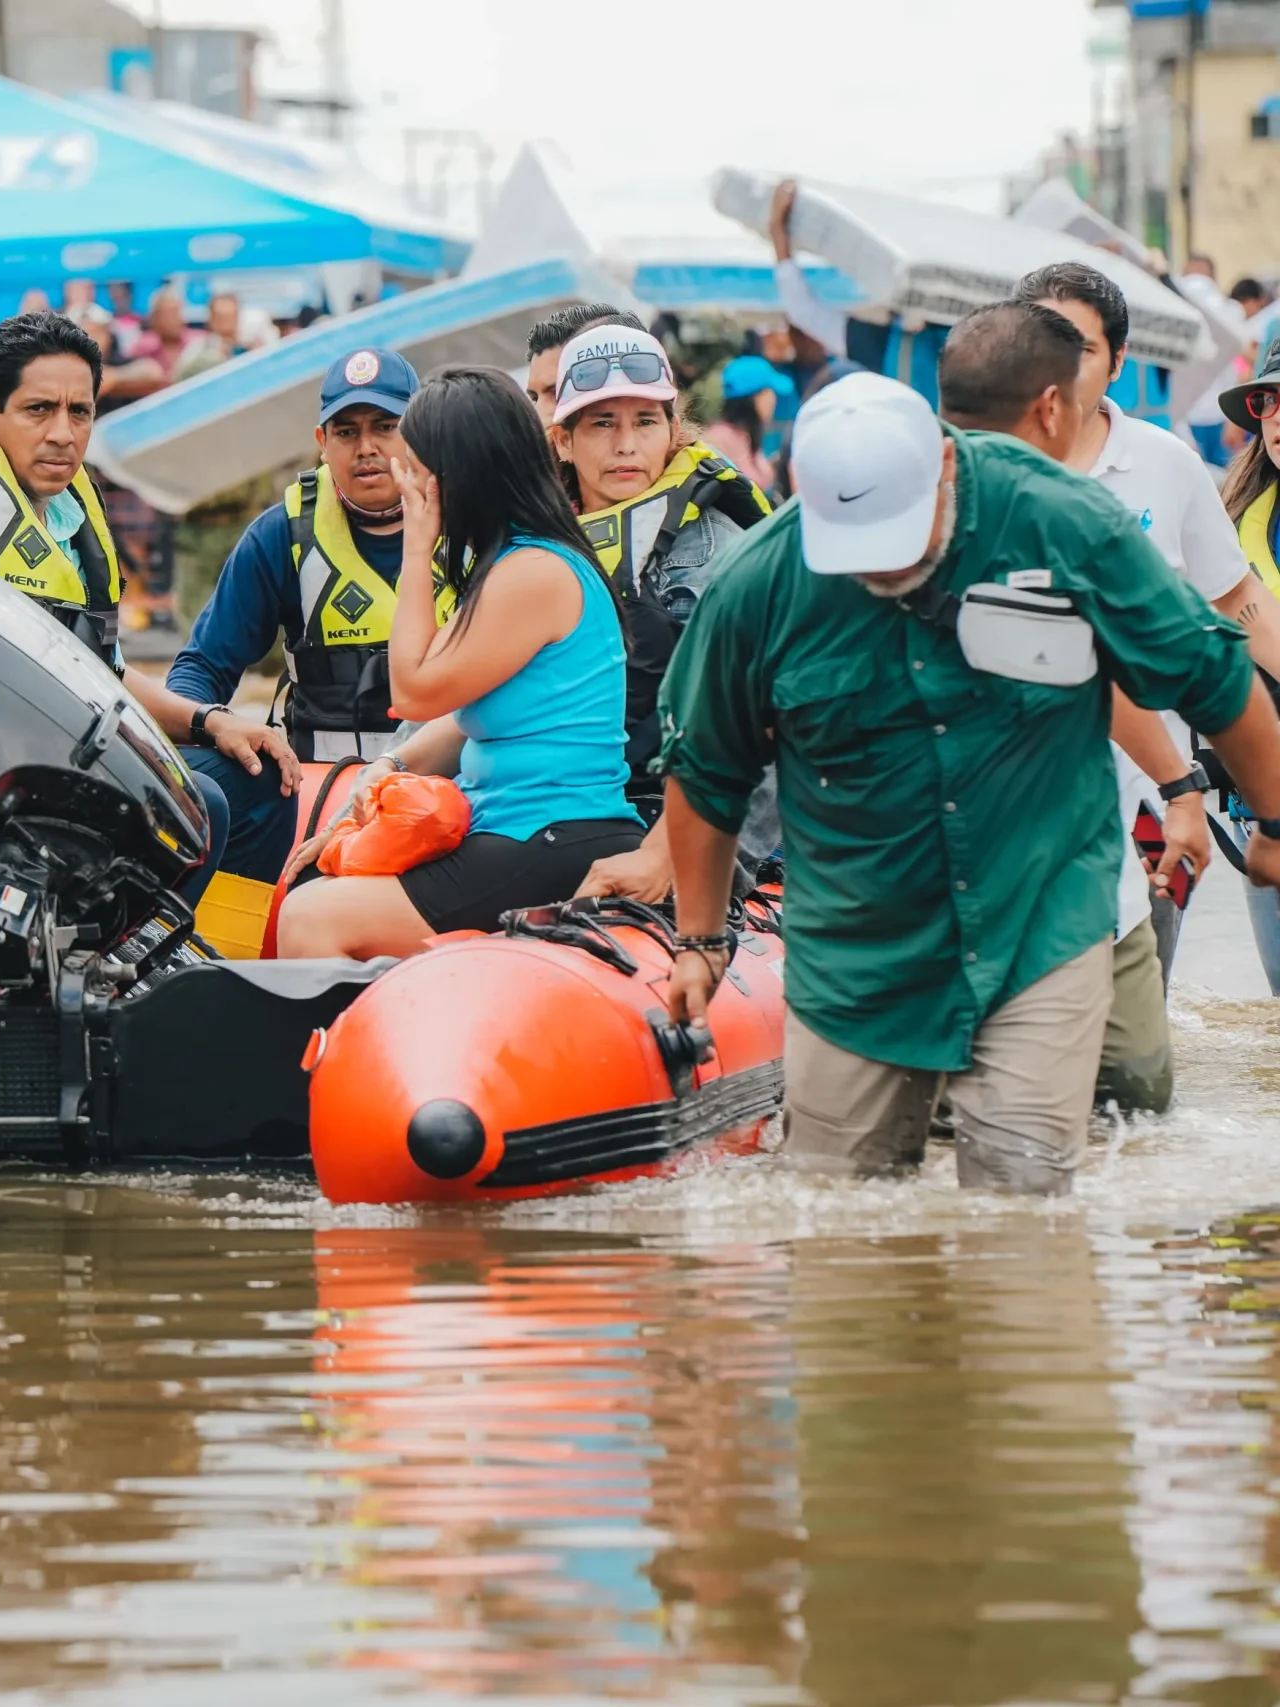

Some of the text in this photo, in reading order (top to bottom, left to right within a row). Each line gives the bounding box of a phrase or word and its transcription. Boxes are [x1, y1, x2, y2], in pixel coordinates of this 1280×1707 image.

[577, 342, 640, 360] FAMILIA
[4, 573, 48, 589] KENT
[327, 627, 371, 639] KENT
